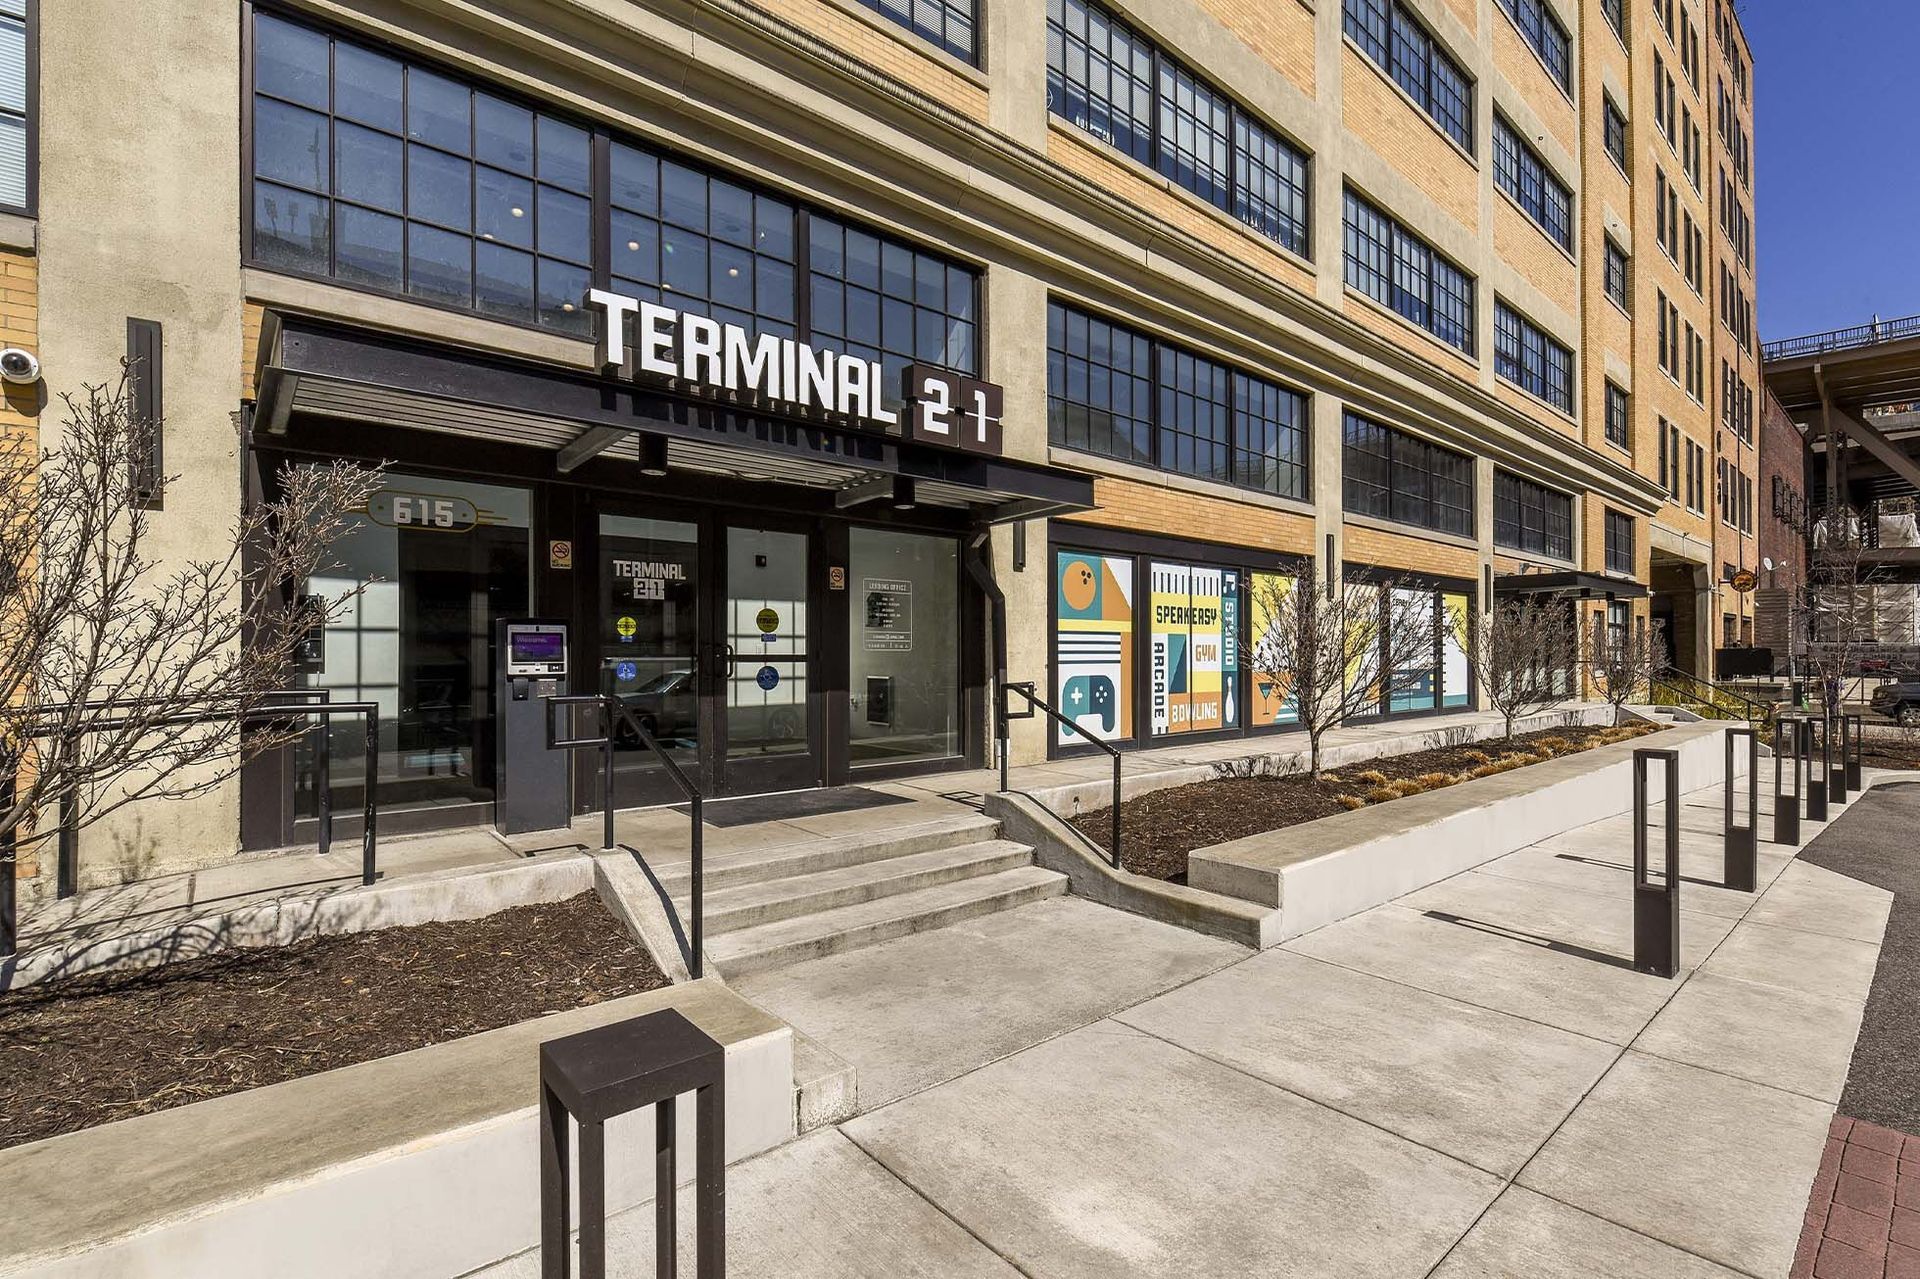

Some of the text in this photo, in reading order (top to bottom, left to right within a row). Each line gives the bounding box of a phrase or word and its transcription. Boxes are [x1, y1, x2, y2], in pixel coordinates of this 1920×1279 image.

[589, 288, 988, 444] TERMINAL 21
[394, 497, 453, 527] 615
[612, 560, 687, 580] TERMINAL
[637, 580, 660, 597] 21
[1156, 605, 1217, 626] SPEAKEASY
[1225, 601, 1235, 667] STUDIO
[1195, 644, 1217, 662] GYM
[1154, 642, 1165, 719] ARCADE
[1172, 701, 1218, 723] BOWLING
